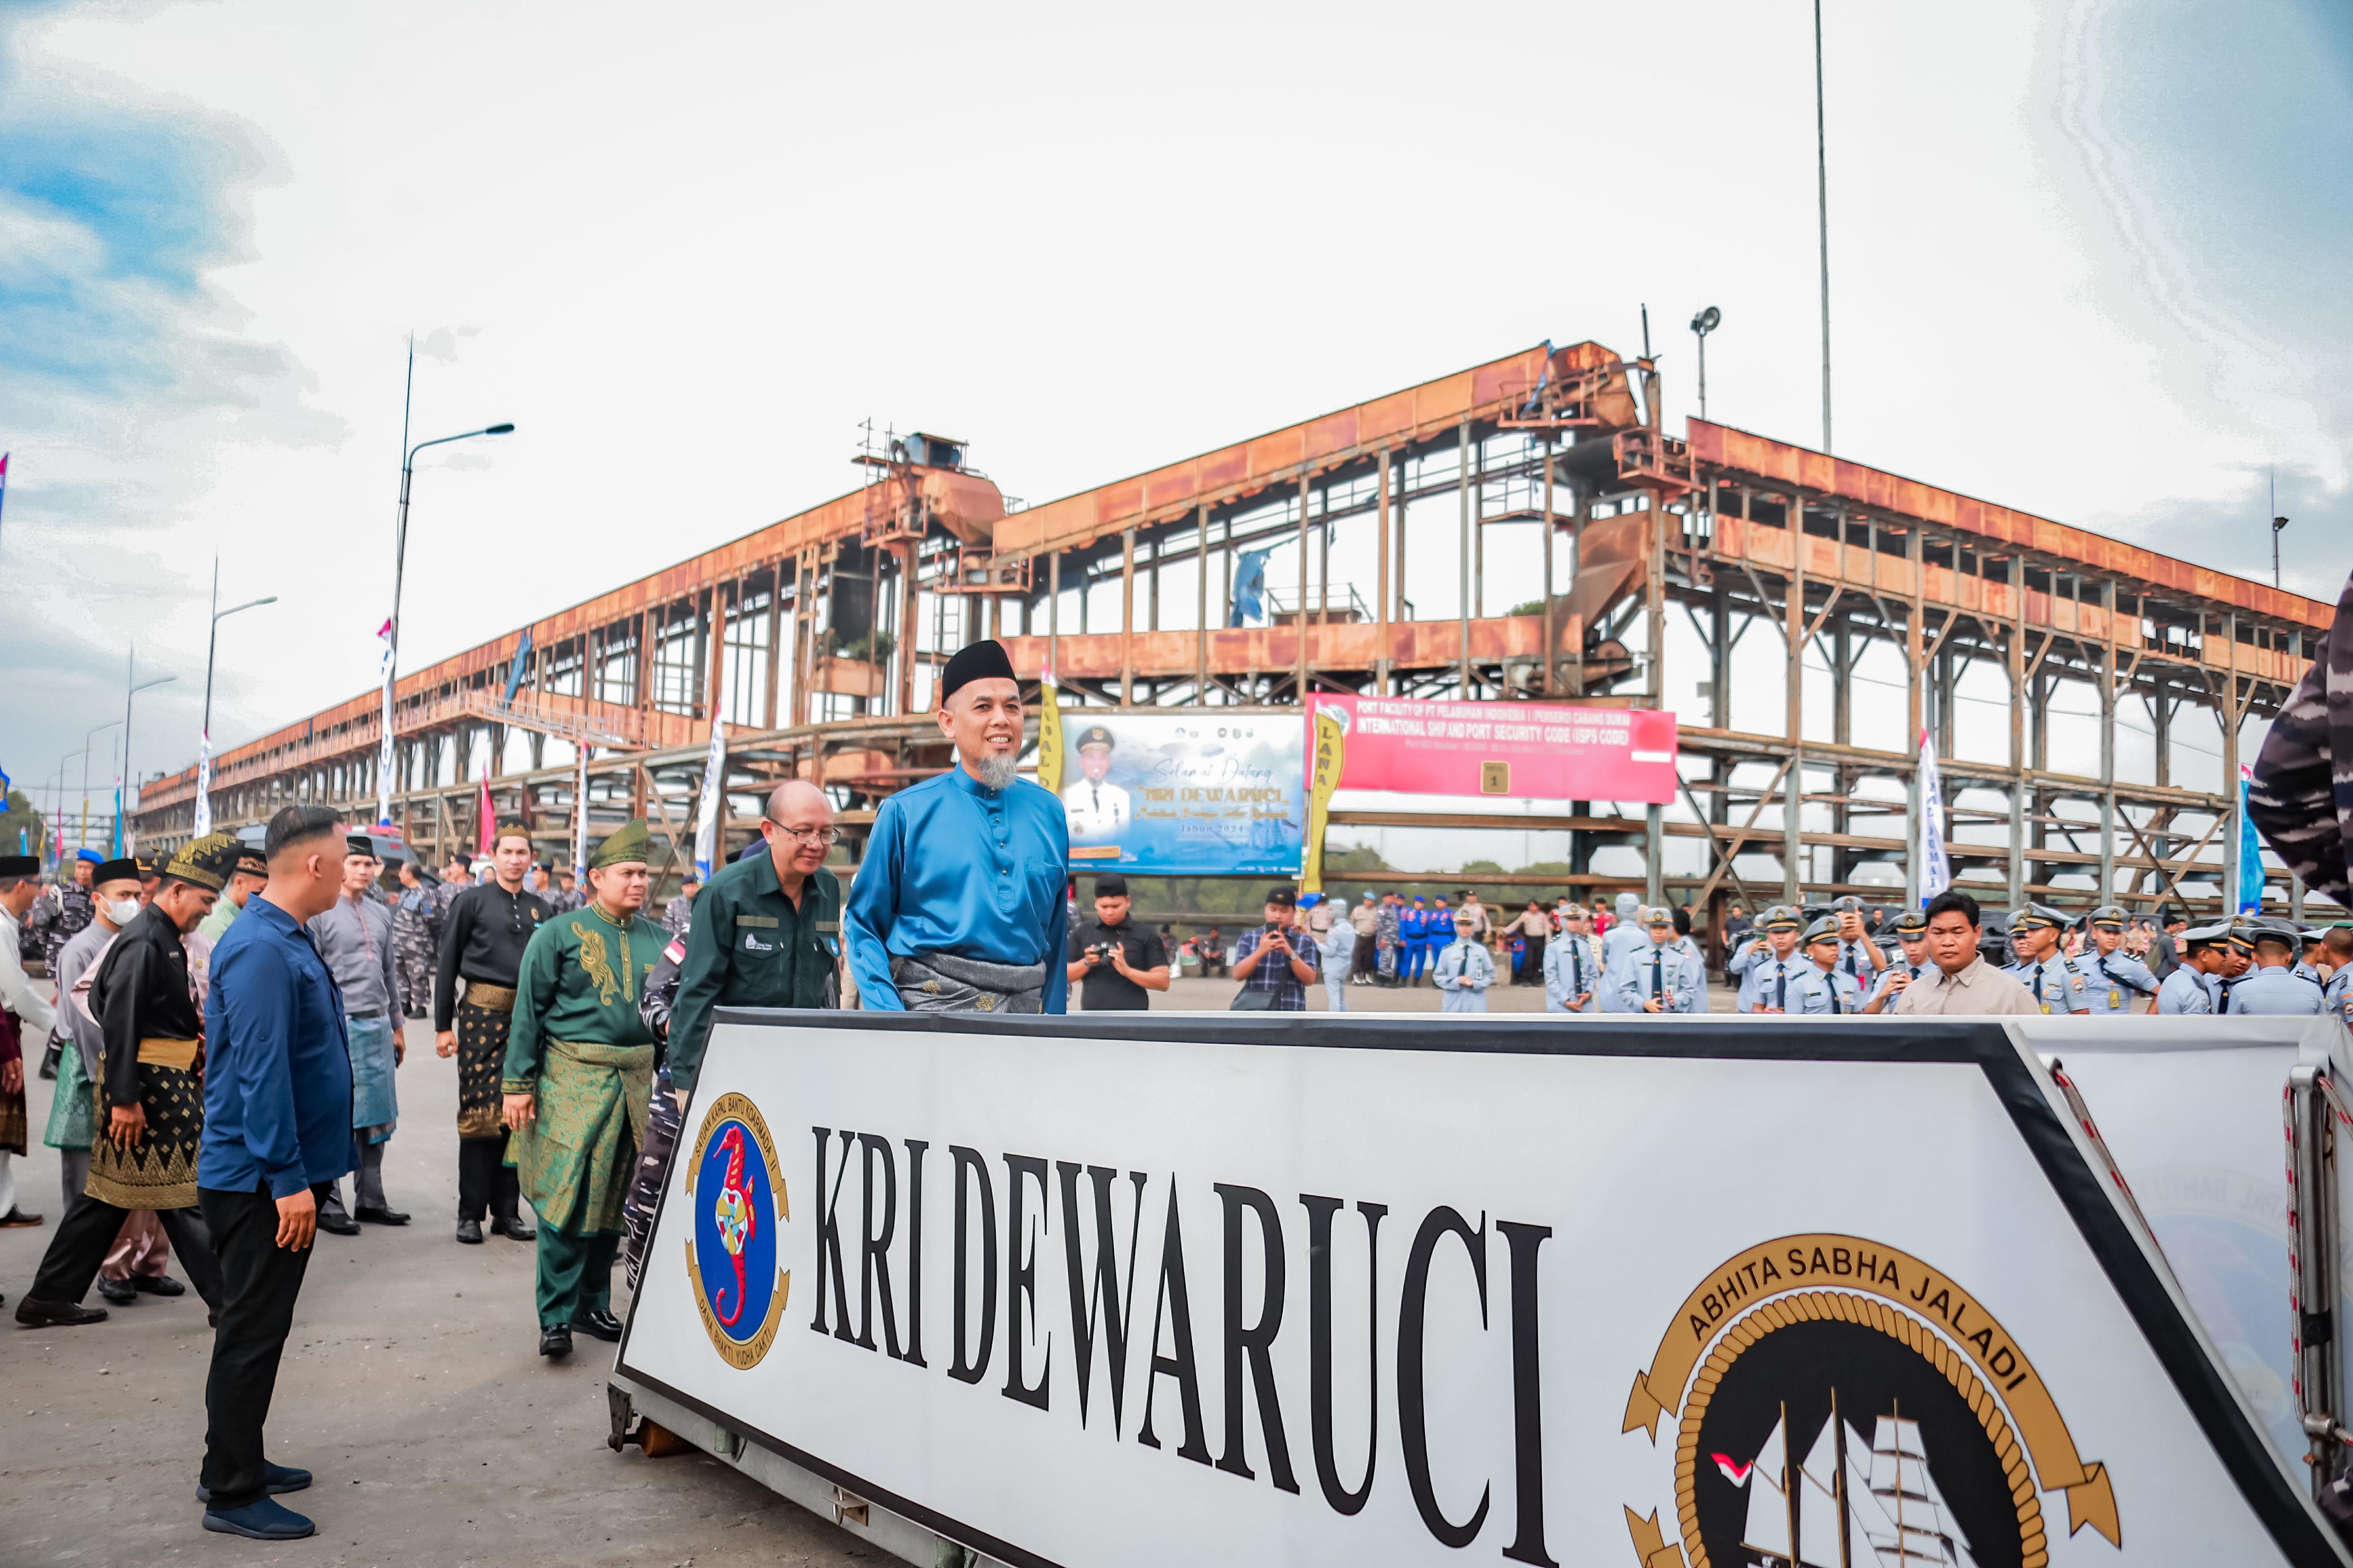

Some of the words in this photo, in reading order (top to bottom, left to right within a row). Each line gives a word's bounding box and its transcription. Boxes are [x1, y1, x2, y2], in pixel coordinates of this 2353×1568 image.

[1356, 701, 1377, 714] PORT
[1380, 702, 1412, 716] FACILITY
[1414, 705, 1423, 716] OF
[1425, 705, 1436, 717] PT
[1437, 705, 1482, 719] PELABUHAN
[1484, 708, 1525, 722] INDONESIA
[1532, 710, 1571, 724] (PERSERO)
[1573, 712, 1604, 725] CABANG
[1606, 714, 1631, 726] DUMAI
[1358, 717, 1425, 736] INTERNATIONAL
[1427, 720, 1446, 737] SHIP
[1447, 722, 1464, 738] AND
[1466, 723, 1491, 740] PORT
[1494, 724, 1541, 742] SECURITY
[1544, 727, 1571, 744] CODE
[1572, 728, 1598, 745] (ISPS
[1599, 729, 1629, 746] CODE)
[1154, 758, 1213, 784] Selamat
[1222, 758, 1272, 784] Datang
[1318, 726, 1333, 799] LANA
[696, 1117, 712, 1157] SATUAN
[711, 1099, 726, 1124] KAPAL
[729, 1097, 745, 1115] BANTU
[746, 1103, 772, 1158] KOARMADA
[770, 1159, 777, 1172] II
[699, 1298, 713, 1334] DANA
[714, 1329, 733, 1362] BHAKTI
[736, 1348, 755, 1365] YUDHA
[755, 1327, 772, 1358] CAKTI
[810, 1126, 929, 1367] KRI
[947, 1144, 1559, 1568] DEWARUCI
[1688, 1255, 1781, 1342] ABHITA
[1787, 1247, 1901, 1290] SABHA
[1910, 1276, 2027, 1391] JALADI
